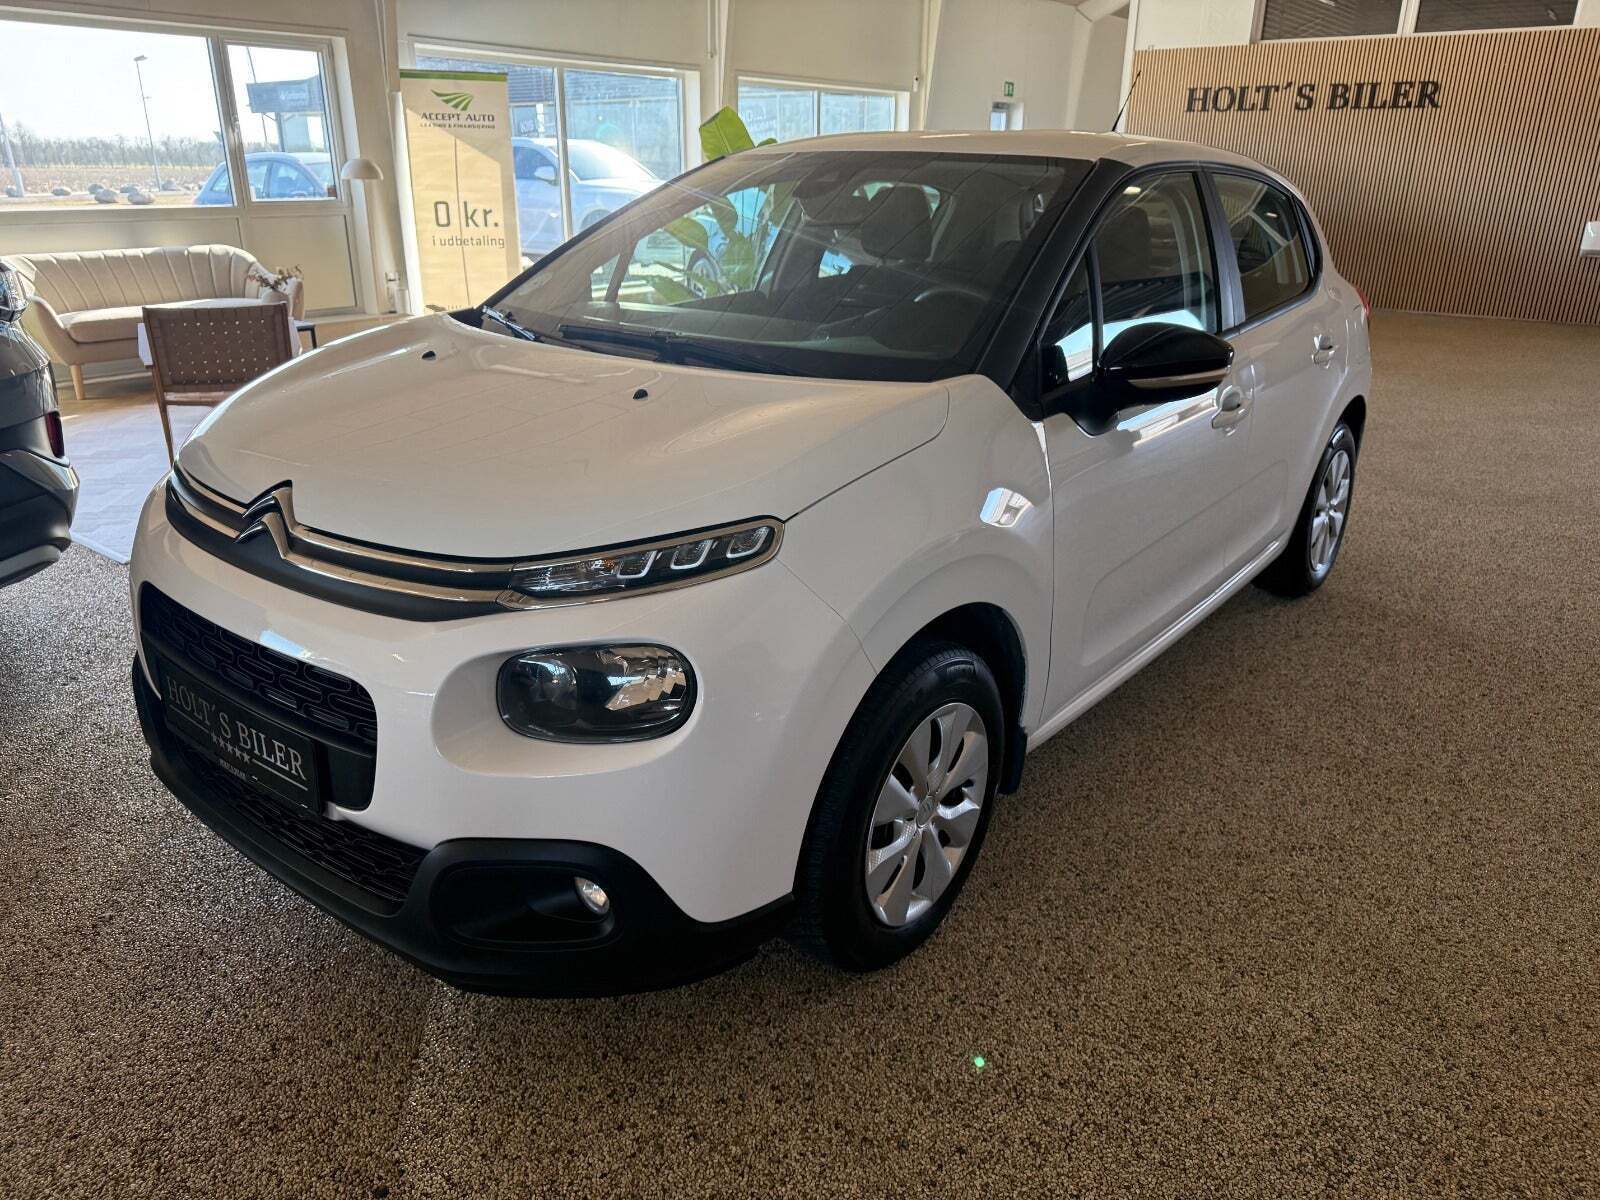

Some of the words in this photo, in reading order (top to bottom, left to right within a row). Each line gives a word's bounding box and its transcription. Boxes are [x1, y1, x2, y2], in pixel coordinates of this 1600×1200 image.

[1326, 80, 1442, 110] BILER
[420, 112, 461, 121] ACCEPT
[465, 113, 495, 122] AUTO
[433, 200, 451, 227] 0
[463, 200, 499, 228] kr.
[439, 234, 505, 249] udbetaling
[235, 720, 307, 781] BILER
